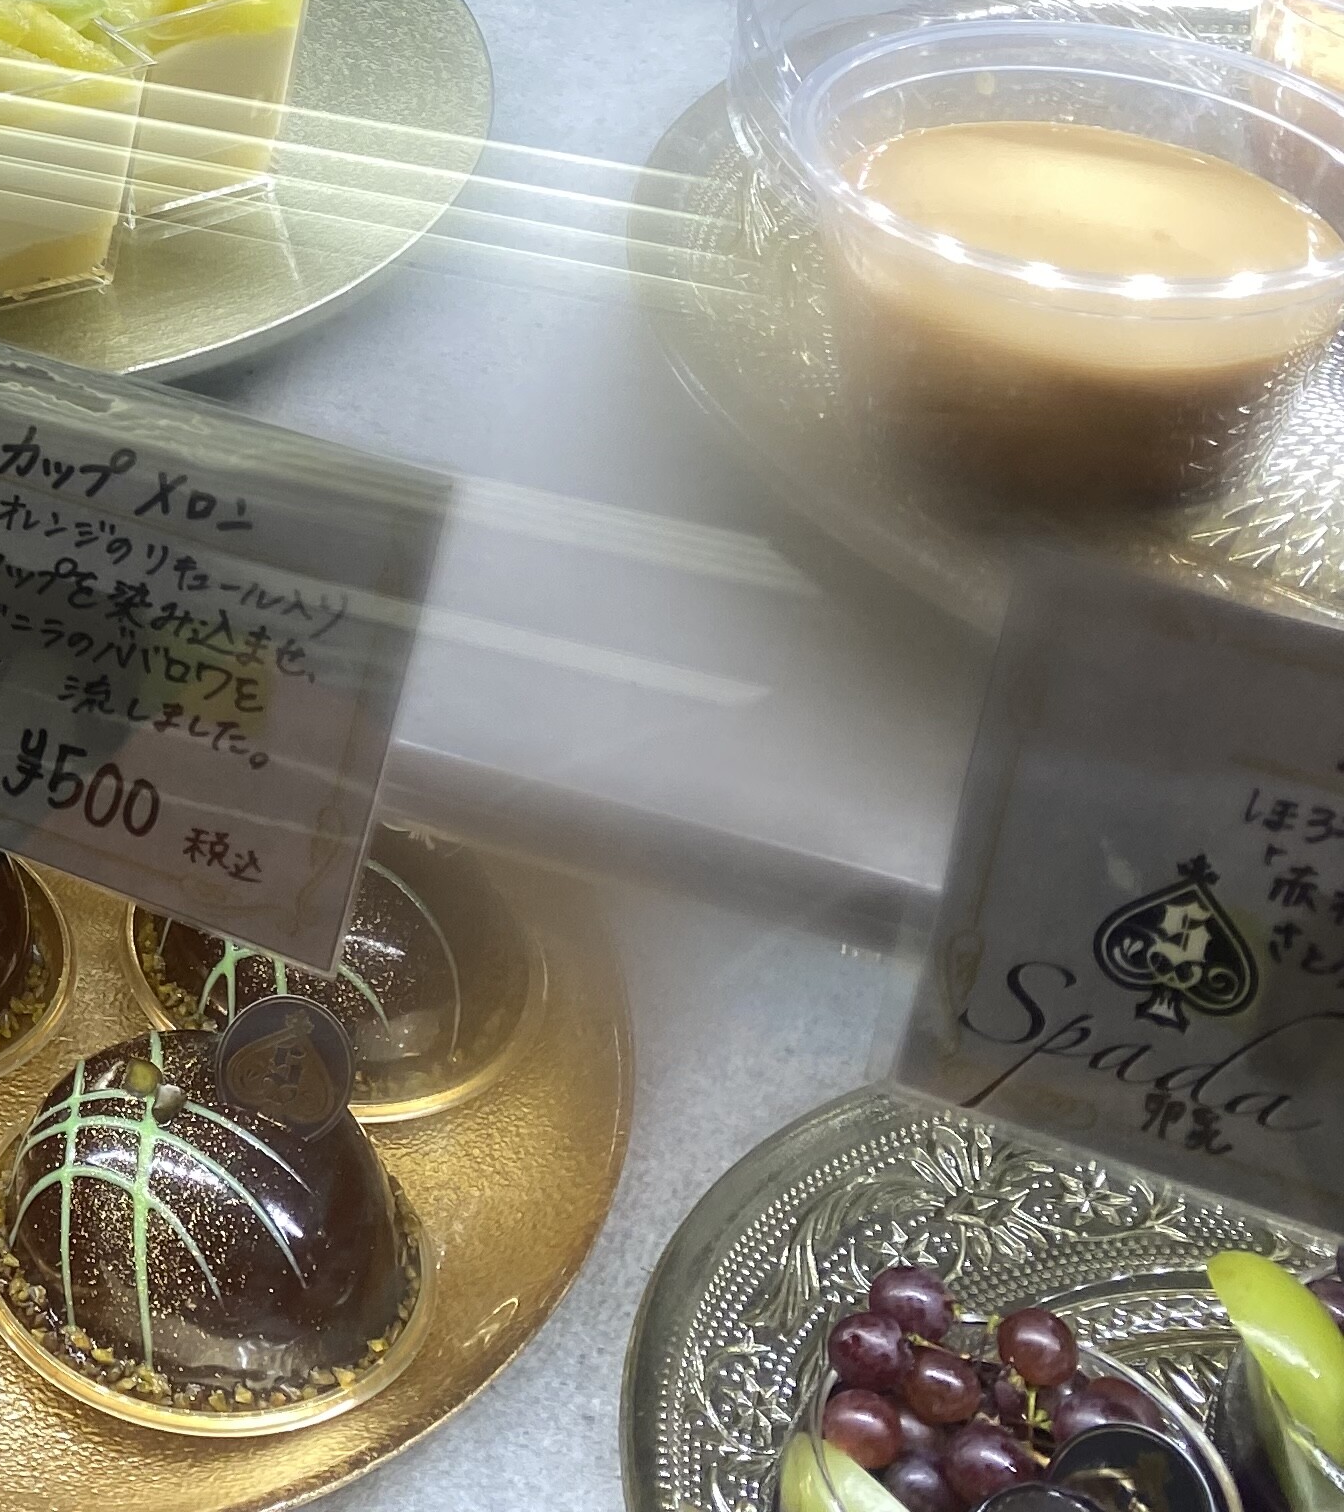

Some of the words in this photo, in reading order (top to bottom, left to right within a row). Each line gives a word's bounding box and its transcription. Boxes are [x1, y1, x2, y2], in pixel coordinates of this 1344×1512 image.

[59, 673, 271, 769] 流しました。
[1, 729, 161, 836] ¥500
[182, 827, 262, 883] 税込
[961, 960, 1344, 1133] Spada
